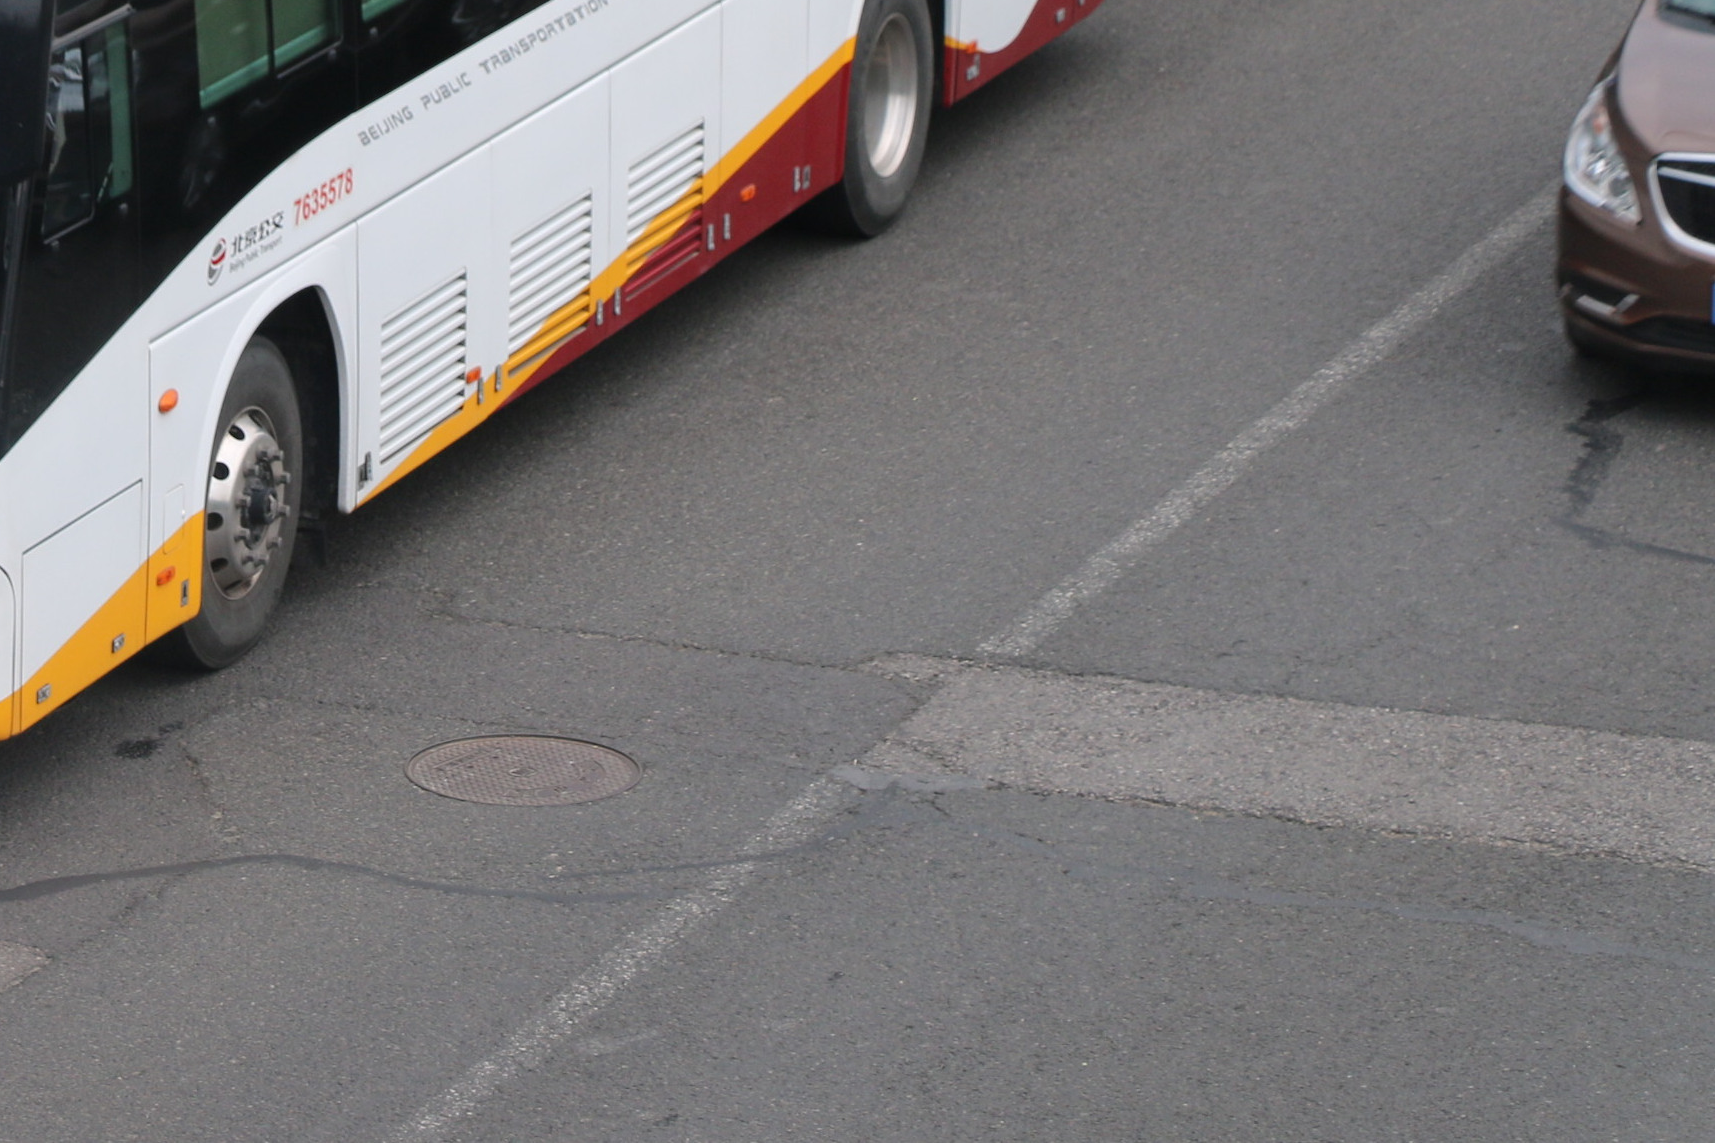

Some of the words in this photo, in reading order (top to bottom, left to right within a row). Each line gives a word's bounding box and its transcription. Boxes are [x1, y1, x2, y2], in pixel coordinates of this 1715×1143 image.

[358, 105, 414, 147] BEIJING
[420, 72, 473, 110] PUBLIC
[293, 167, 354, 227] 7635578
